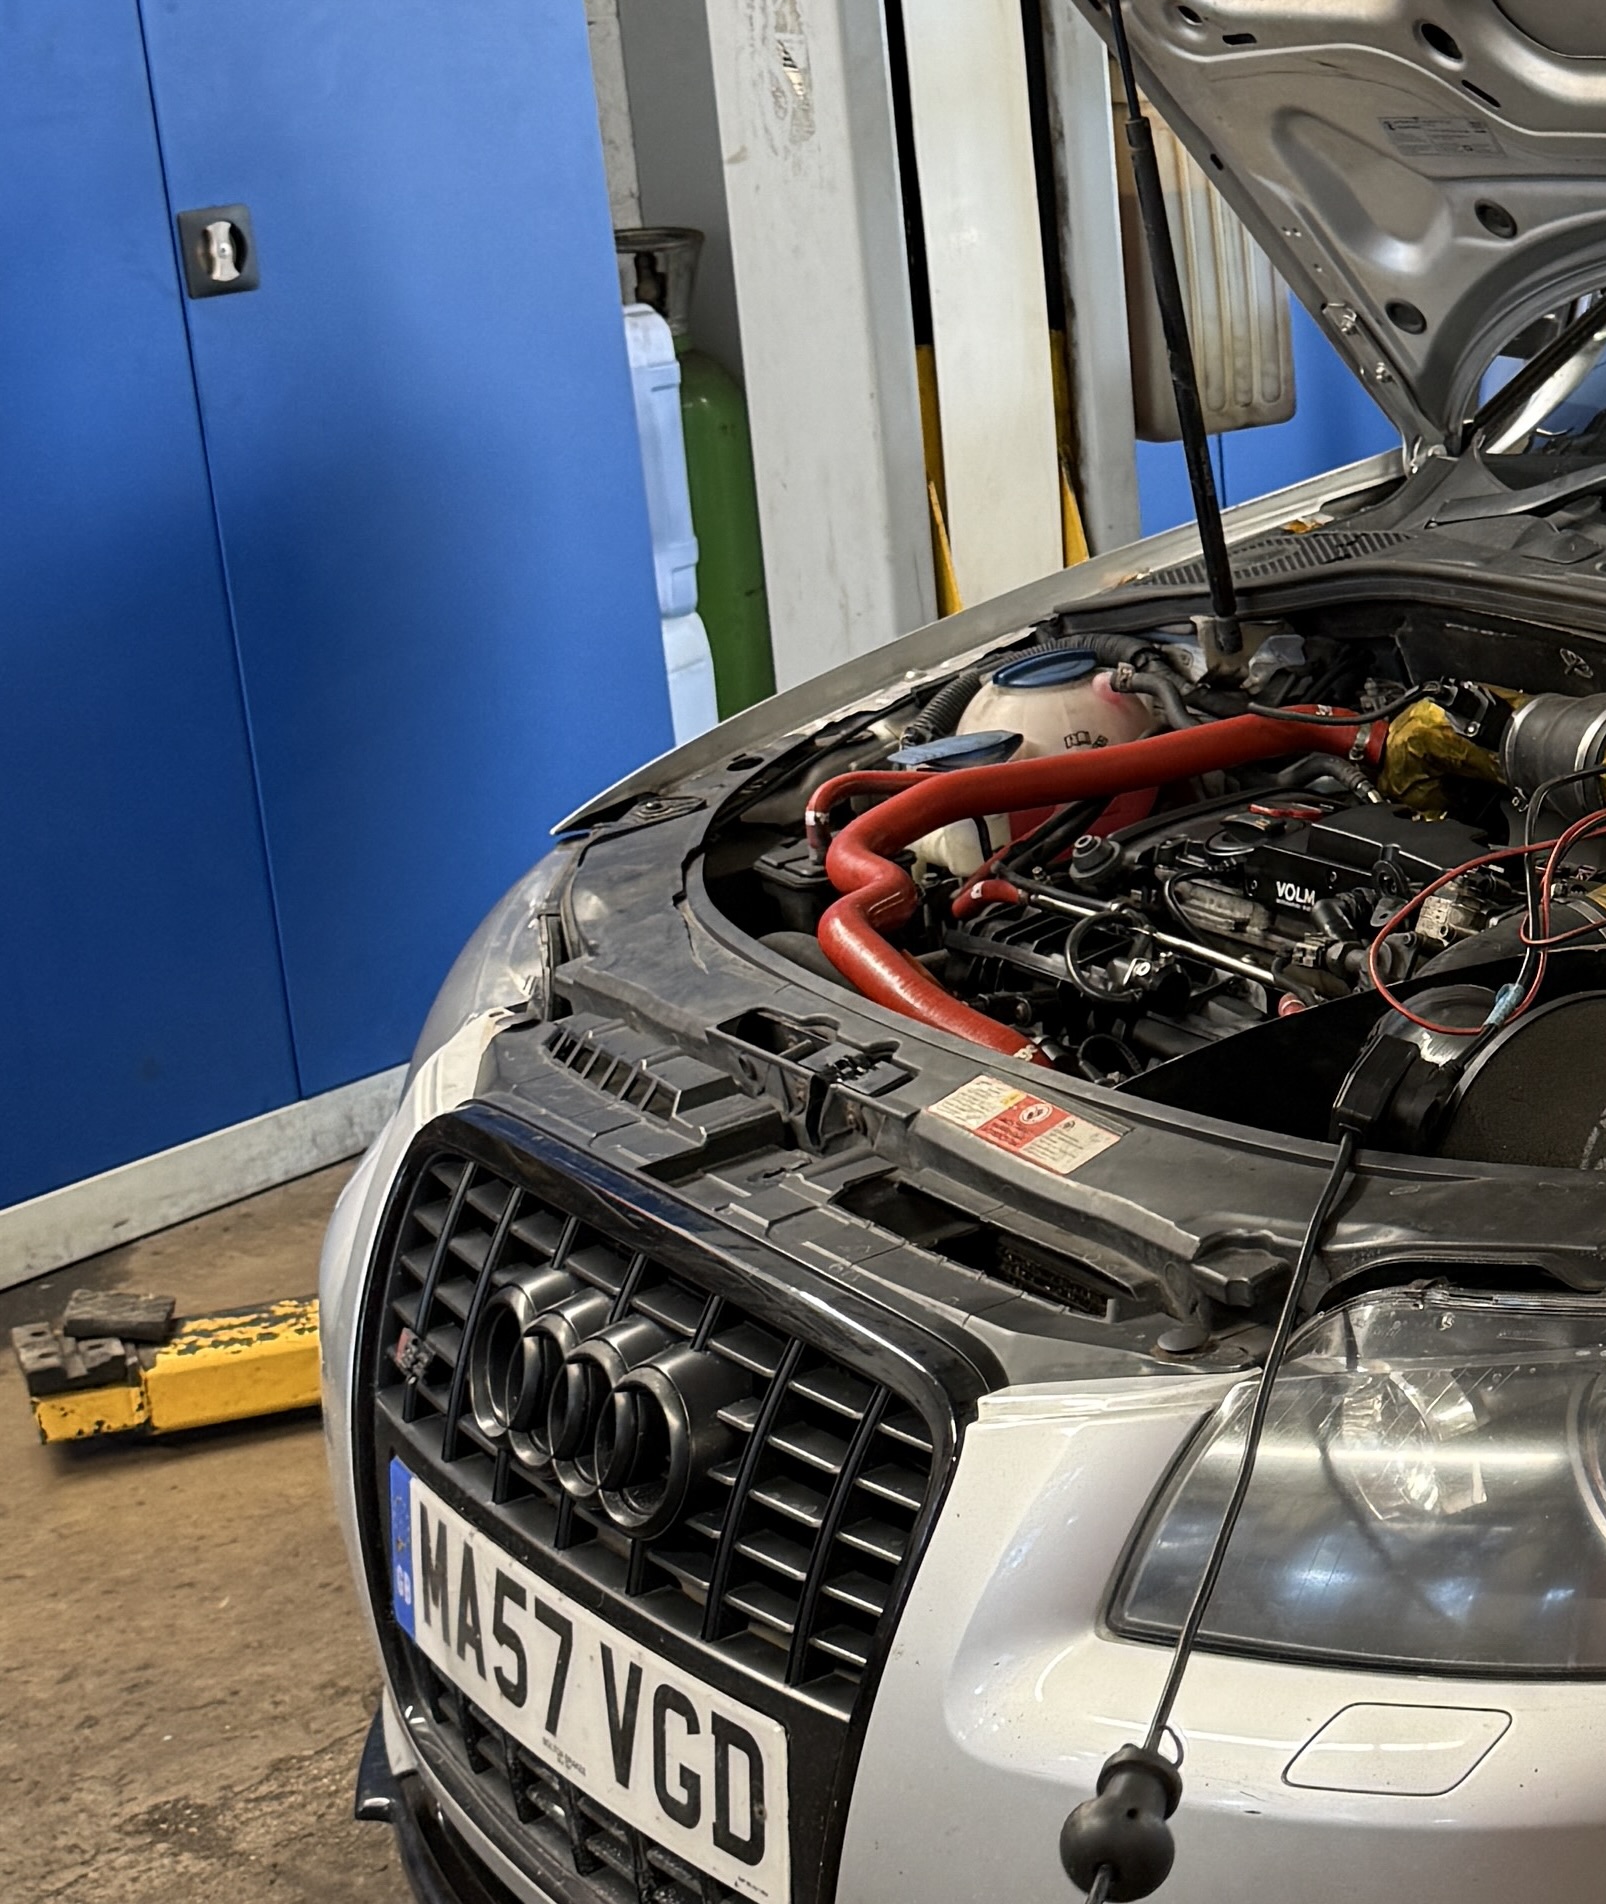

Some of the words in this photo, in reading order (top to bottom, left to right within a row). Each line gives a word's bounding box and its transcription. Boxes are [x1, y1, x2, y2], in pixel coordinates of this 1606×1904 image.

[1276, 880, 1316, 906] VOLM
[396, 1563, 412, 1606] GB
[419, 1500, 573, 1737] MA57
[600, 1640, 766, 1866] VGD
